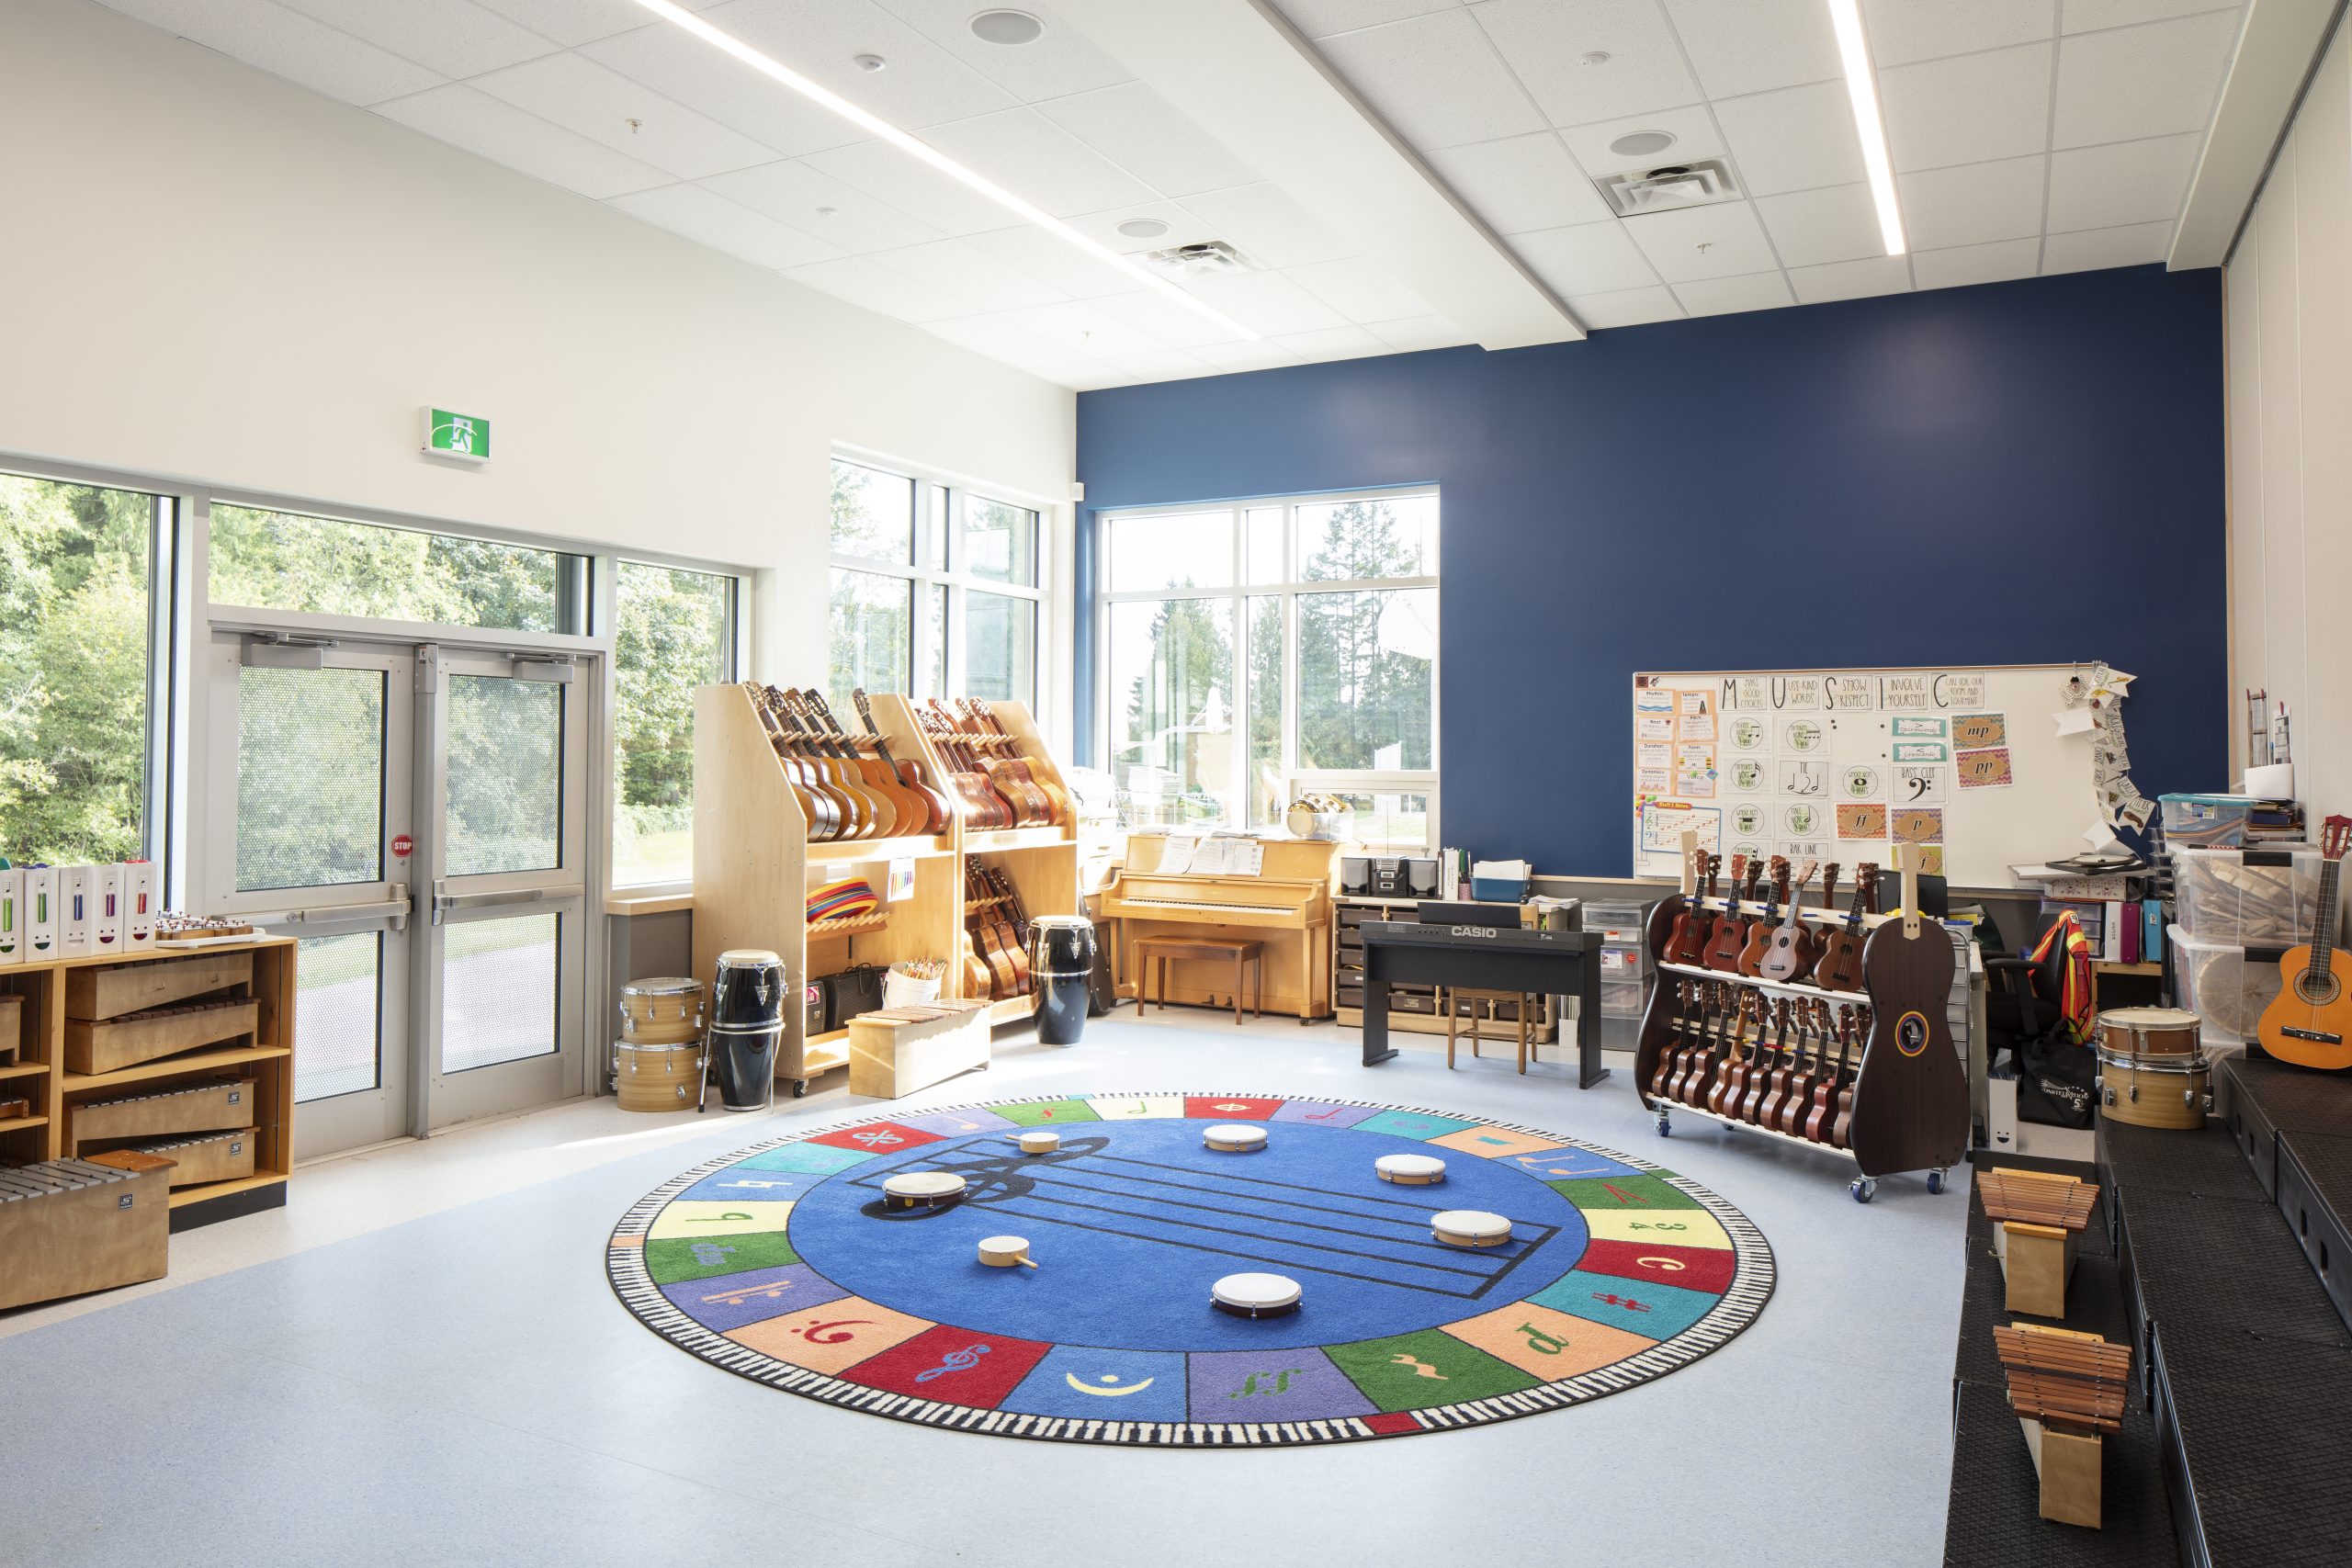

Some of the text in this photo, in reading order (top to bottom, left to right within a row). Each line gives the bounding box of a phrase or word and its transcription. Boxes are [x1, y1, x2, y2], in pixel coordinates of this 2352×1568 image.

[1788, 680, 1818, 691] USE KIND
[1842, 678, 1868, 692] SHOW
[1891, 678, 1924, 691] INVOLVE
[1972, 677, 1984, 685] OUR
[1722, 678, 1738, 710] M
[1743, 689, 1760, 698] GOOD
[1771, 677, 1786, 709] U
[1825, 677, 1838, 710] S
[1880, 678, 1883, 710] I
[1934, 674, 1949, 708] C
[1967, 687, 1978, 695] AND
[1740, 699, 1763, 708] CHOICES
[1791, 694, 1815, 705] WORDS
[1839, 694, 1870, 707] RESPECT
[1888, 694, 1926, 707] YOURSELF
[1967, 727, 1989, 739] mp
[1901, 766, 1936, 779] BASS CLEF
[1974, 761, 1994, 774] pp
[1913, 819, 1922, 831] p
[394, 841, 413, 851] STOP
[1790, 844, 1817, 855] BAR LINE
[1451, 926, 1497, 939] CASIO
